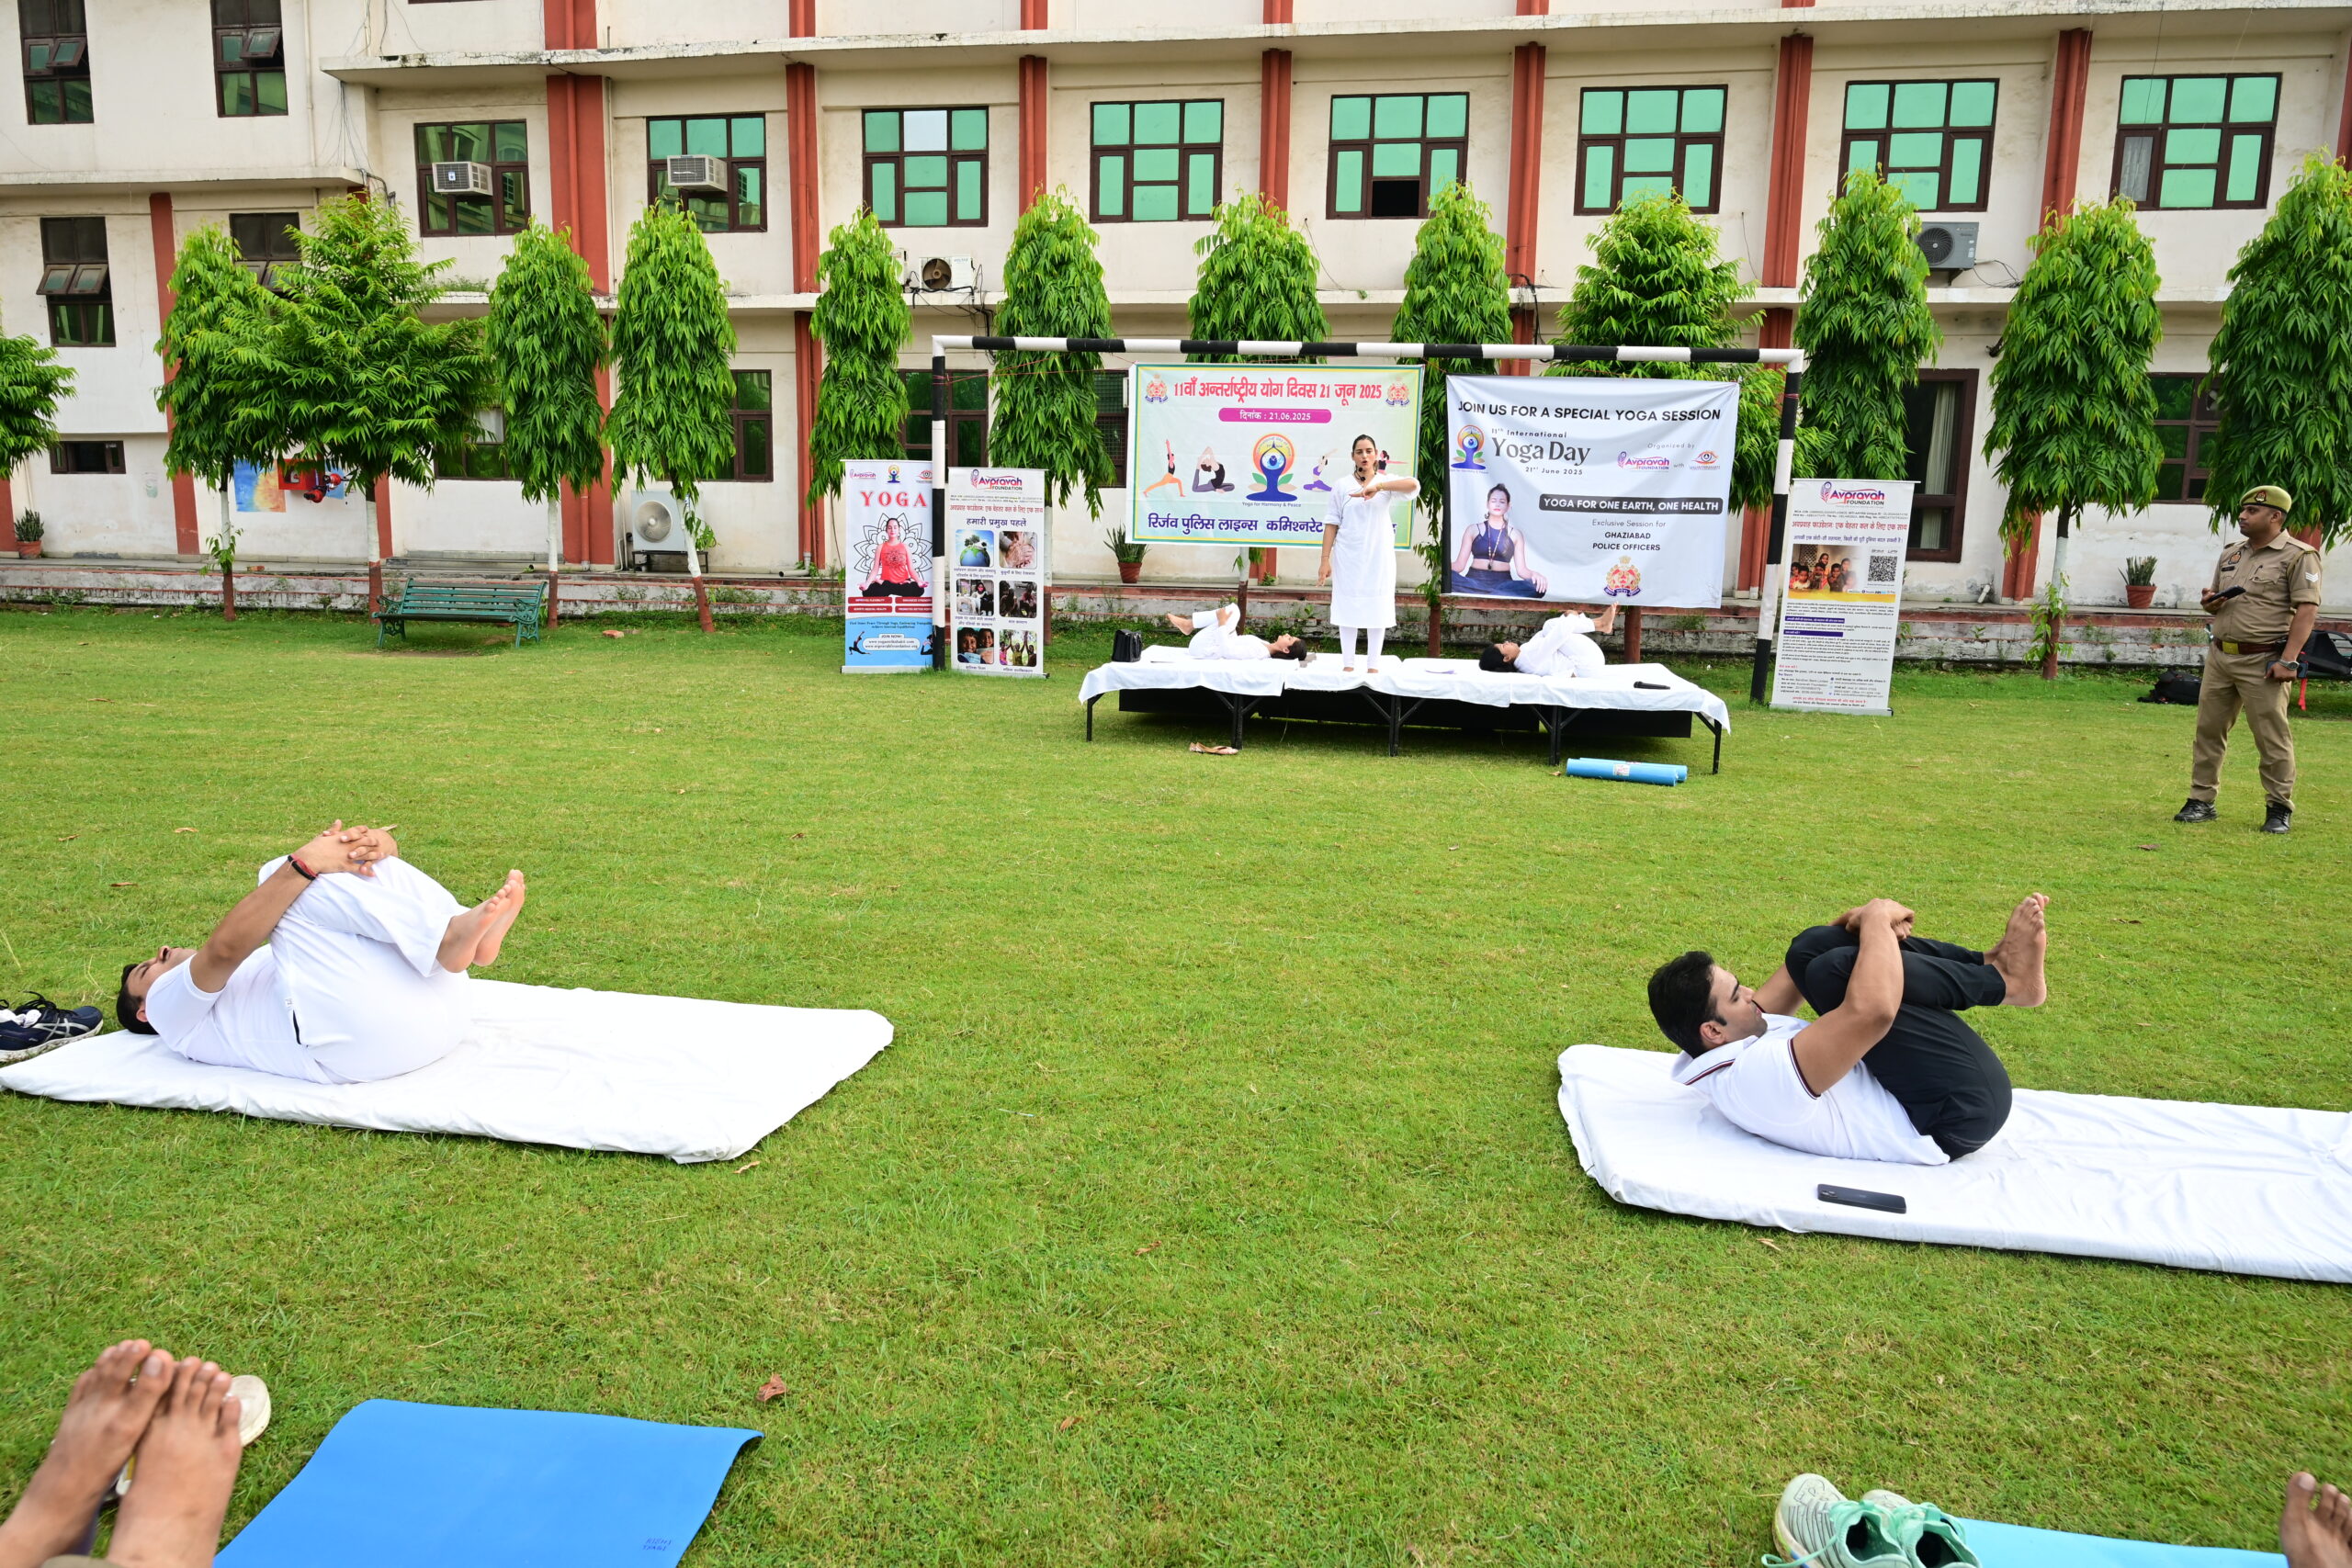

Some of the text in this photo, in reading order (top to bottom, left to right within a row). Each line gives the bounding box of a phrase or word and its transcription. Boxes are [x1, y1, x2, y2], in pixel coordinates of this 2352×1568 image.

[1261, 378, 1283, 398] योग
[1286, 378, 1317, 399] दिवस
[1319, 383, 1330, 398] 21
[1335, 383, 1357, 406] जून
[1360, 385, 1382, 399] 2025
[1239, 410, 1261, 421] दिनांक
[1269, 412, 1311, 421] 21.06.2025
[1458, 401, 1720, 421] JOIN US FOR A SPECIAL YOGA SESSION
[1508, 430, 1567, 438] International
[1492, 437, 1591, 466] Yoga Day
[1625, 457, 1669, 468] Avpravah
[978, 477, 1023, 489] Avpravah
[861, 491, 927, 507] YOGA
[1829, 490, 1884, 502] Avpravah
[1544, 498, 1719, 512] YOGA FOR ONE EARTH, ONE HEALTH
[967, 516, 987, 525] हमारी
[989, 519, 1008, 528] प्रमुख
[1182, 513, 1215, 535] पुलिस
[1218, 518, 1258, 532] लाइन्स
[1267, 516, 1324, 533] कमिश्नरेट
[1592, 542, 1660, 551] POLICE OFFICERS
